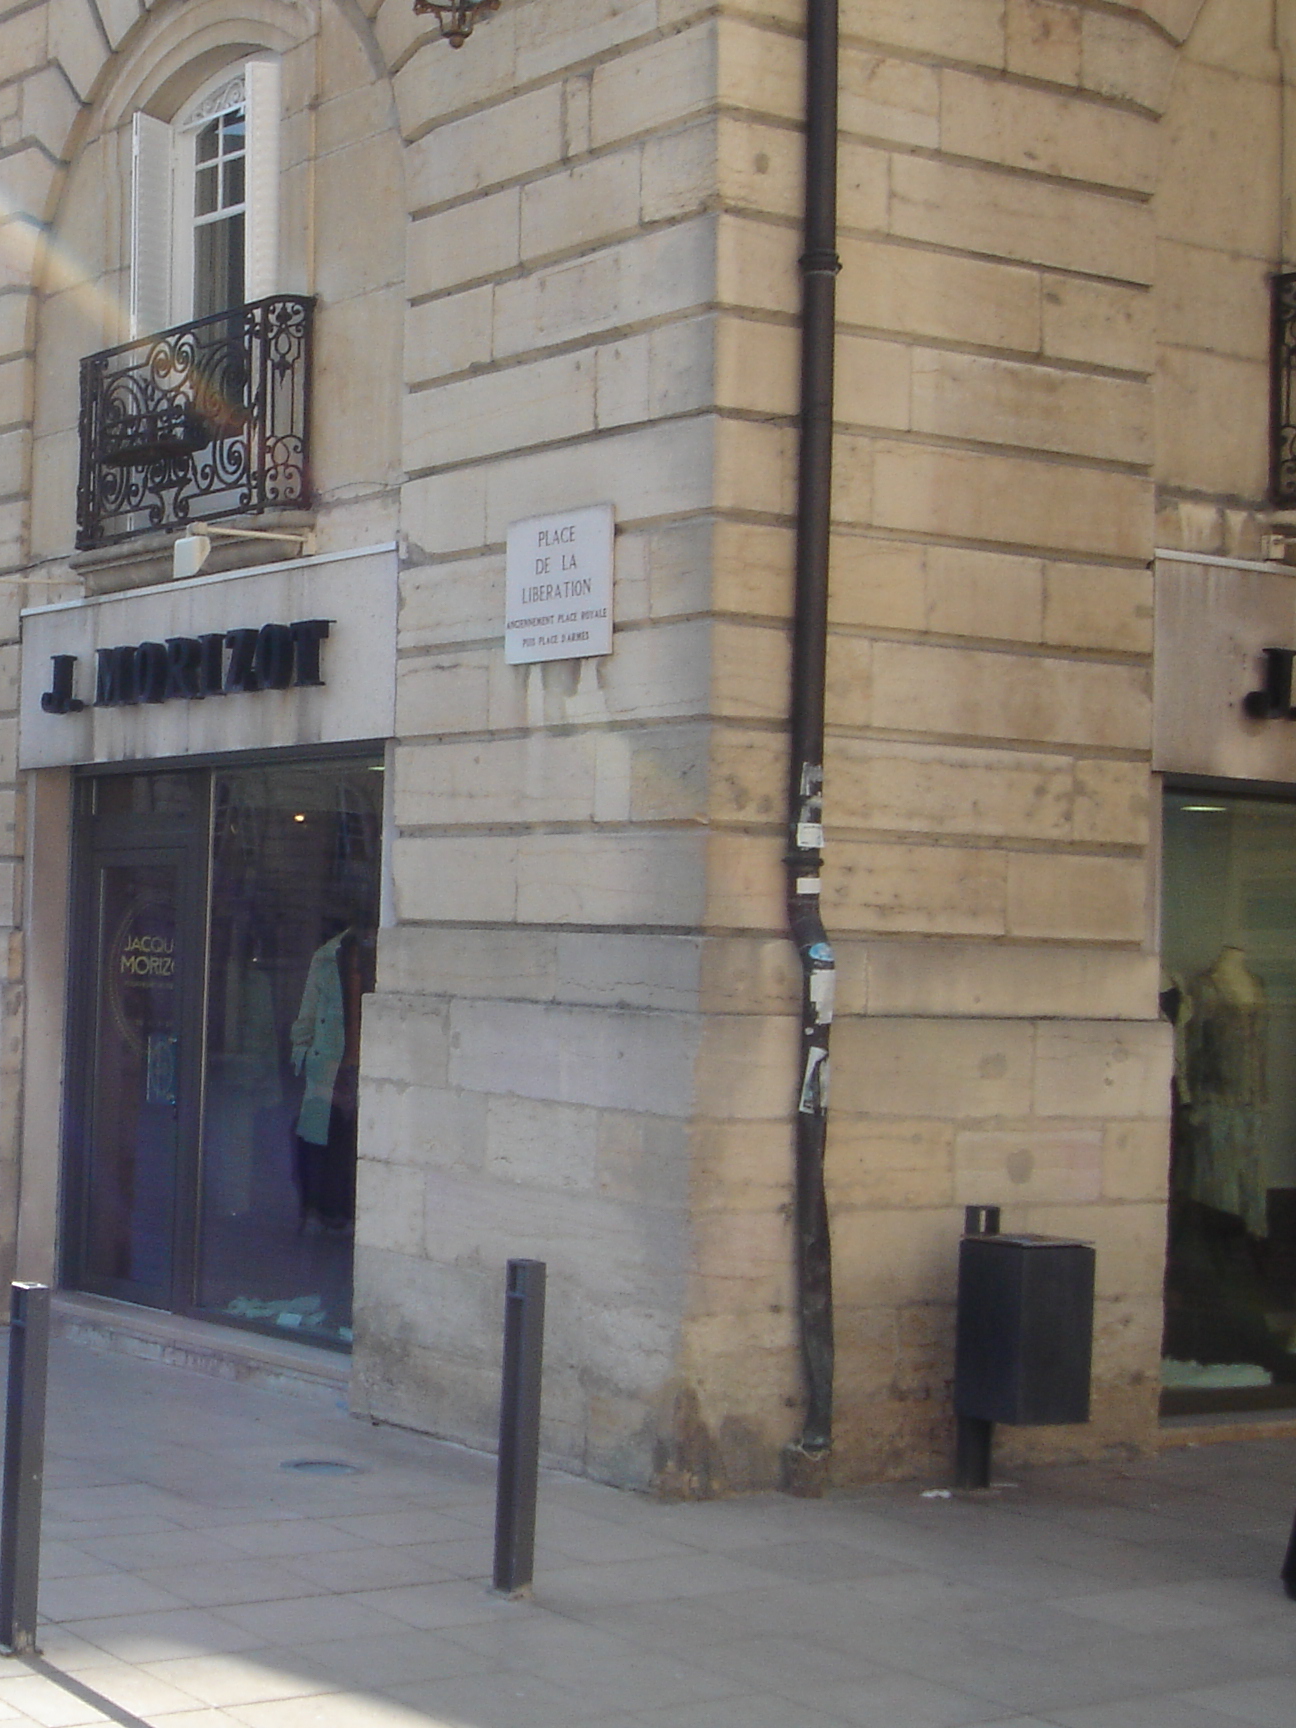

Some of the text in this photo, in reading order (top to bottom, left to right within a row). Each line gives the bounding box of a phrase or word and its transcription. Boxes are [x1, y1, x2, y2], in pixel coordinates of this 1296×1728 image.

[538, 525, 576, 548] PLACE
[535, 554, 577, 575] DE LA
[522, 578, 592, 605] LIBERATION
[557, 612, 577, 623] PLACE
[581, 608, 607, 620] ROYALE
[538, 634, 558, 646] PLACE
[561, 631, 589, 643] DARMES
[41, 619, 337, 714] J. MORIZOT
[120, 956, 174, 976] MORIZ
